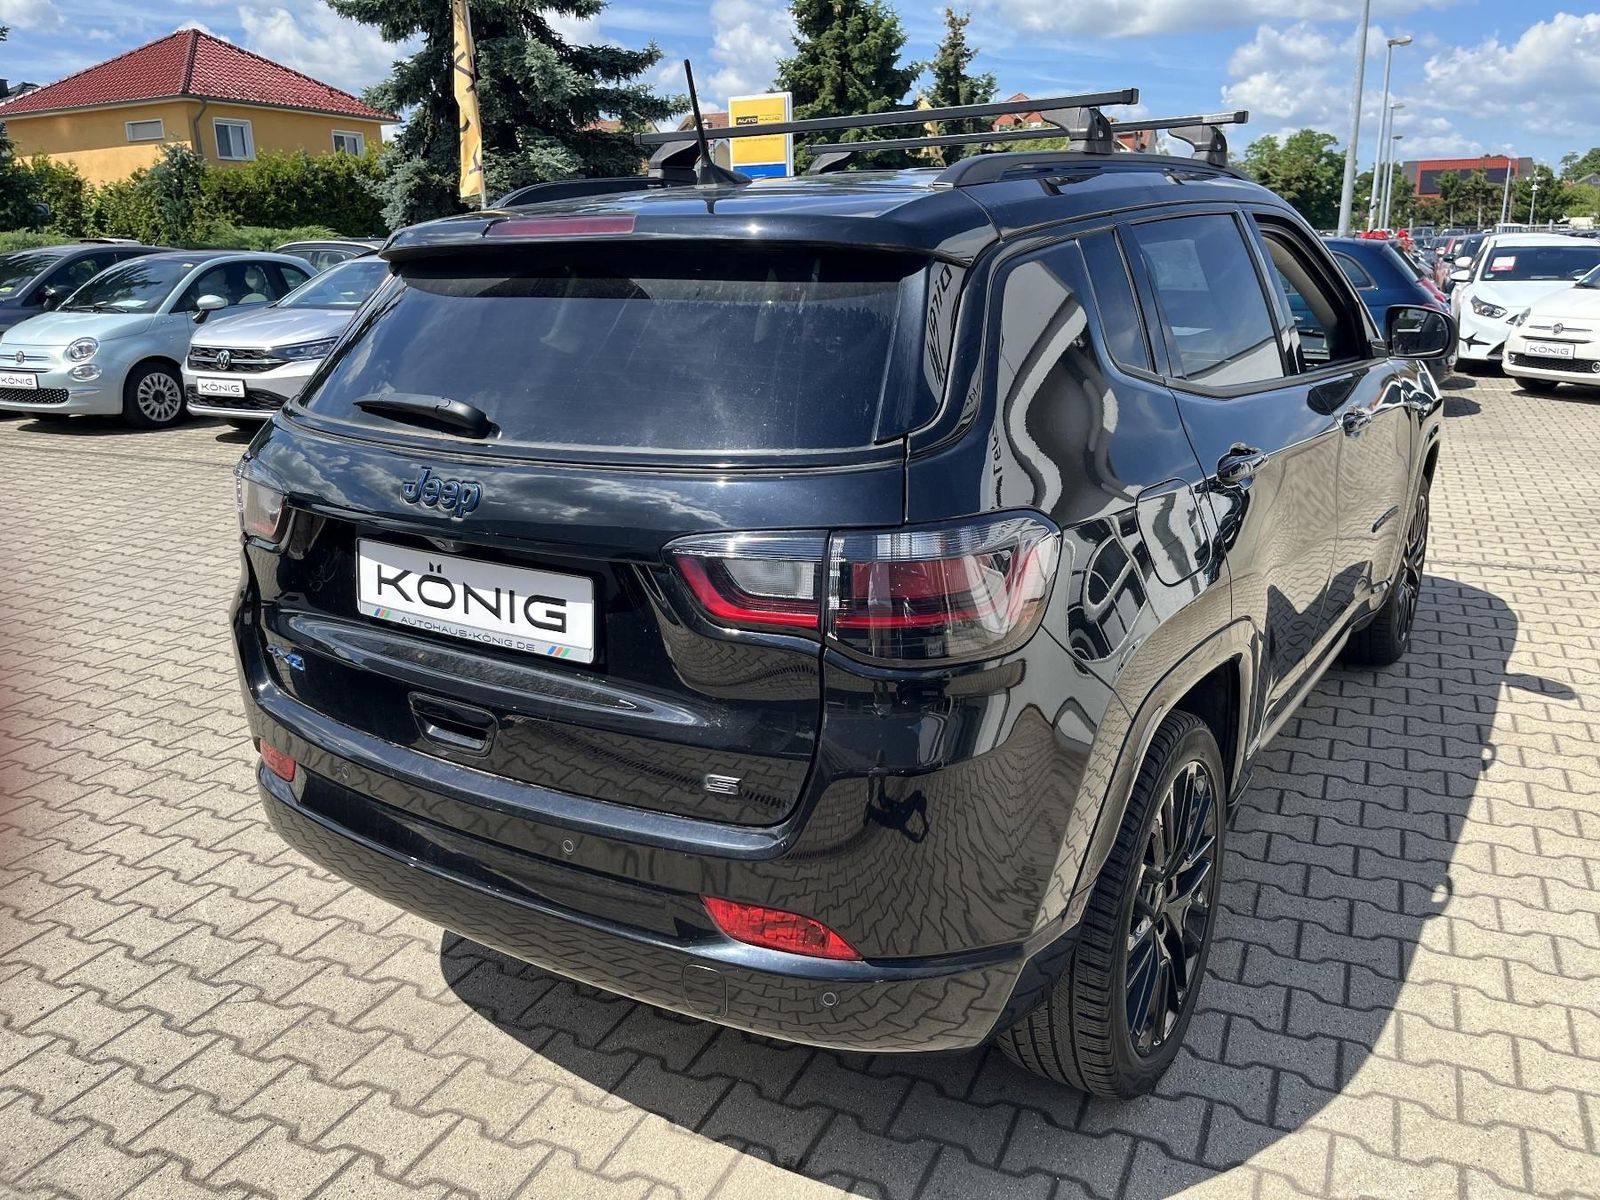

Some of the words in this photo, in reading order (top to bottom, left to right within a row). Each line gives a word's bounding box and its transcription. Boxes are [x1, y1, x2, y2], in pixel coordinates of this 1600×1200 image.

[1530, 345, 1569, 355] KÖNIG
[1, 375, 33, 385] KÖNIG
[201, 381, 240, 392] KÖNIG
[400, 466, 481, 519] Jeep
[377, 561, 567, 634] KÖNIG
